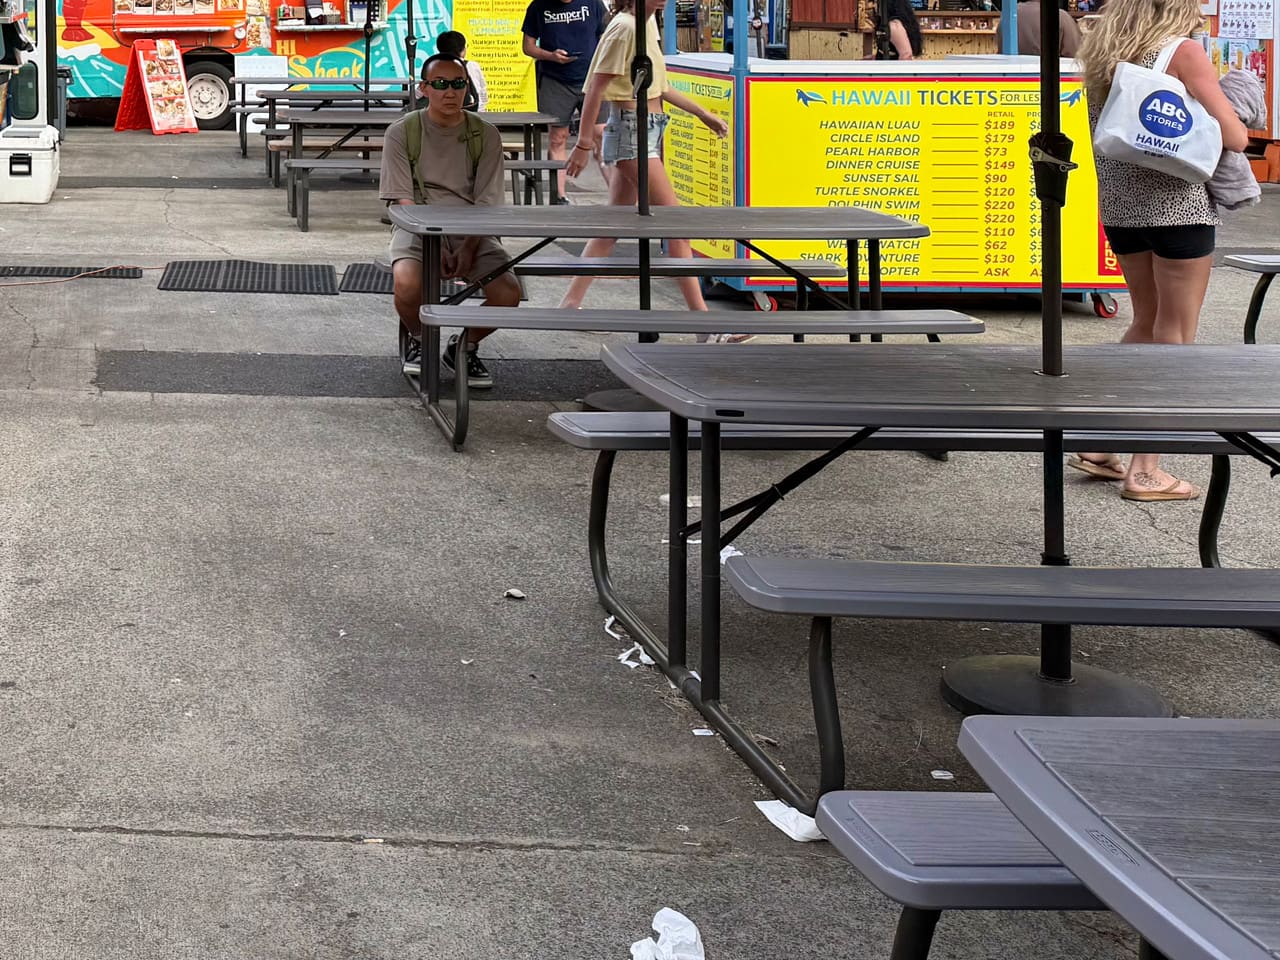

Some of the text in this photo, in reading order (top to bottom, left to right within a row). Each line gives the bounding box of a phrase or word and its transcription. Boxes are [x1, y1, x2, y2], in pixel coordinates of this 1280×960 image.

[543, 10, 581, 24] Semper
[275, 39, 297, 56] HI
[832, 89, 1040, 106] HAWAII TICKETS FOR LES
[1146, 98, 1187, 123] ABC
[819, 120, 885, 130] HAWAIIAN
[887, 120, 920, 130] LUAU
[984, 119, 1015, 131] $189
[1145, 114, 1183, 131] STORES
[830, 133, 1015, 144] CIRCLE ISLAND $179
[1136, 133, 1179, 153] HAWAII
[825, 146, 1007, 157] PEARL HARBOR $73
[825, 160, 1015, 171] DINNER CRUISE $149
[843, 173, 1007, 184] SUNSET SAIL $90
[815, 186, 1015, 197] TURTLE SNORKEL $120
[828, 199, 1015, 211] DOLPHIN SWIM $220
[984, 213, 1015, 224] $220
[984, 226, 1015, 237] $110
[827, 240, 869, 249] WHLE
[984, 240, 1007, 250] $62
[799, 253, 841, 262] SHARK
[984, 253, 1015, 264] $130
[984, 267, 1010, 277] ASK
